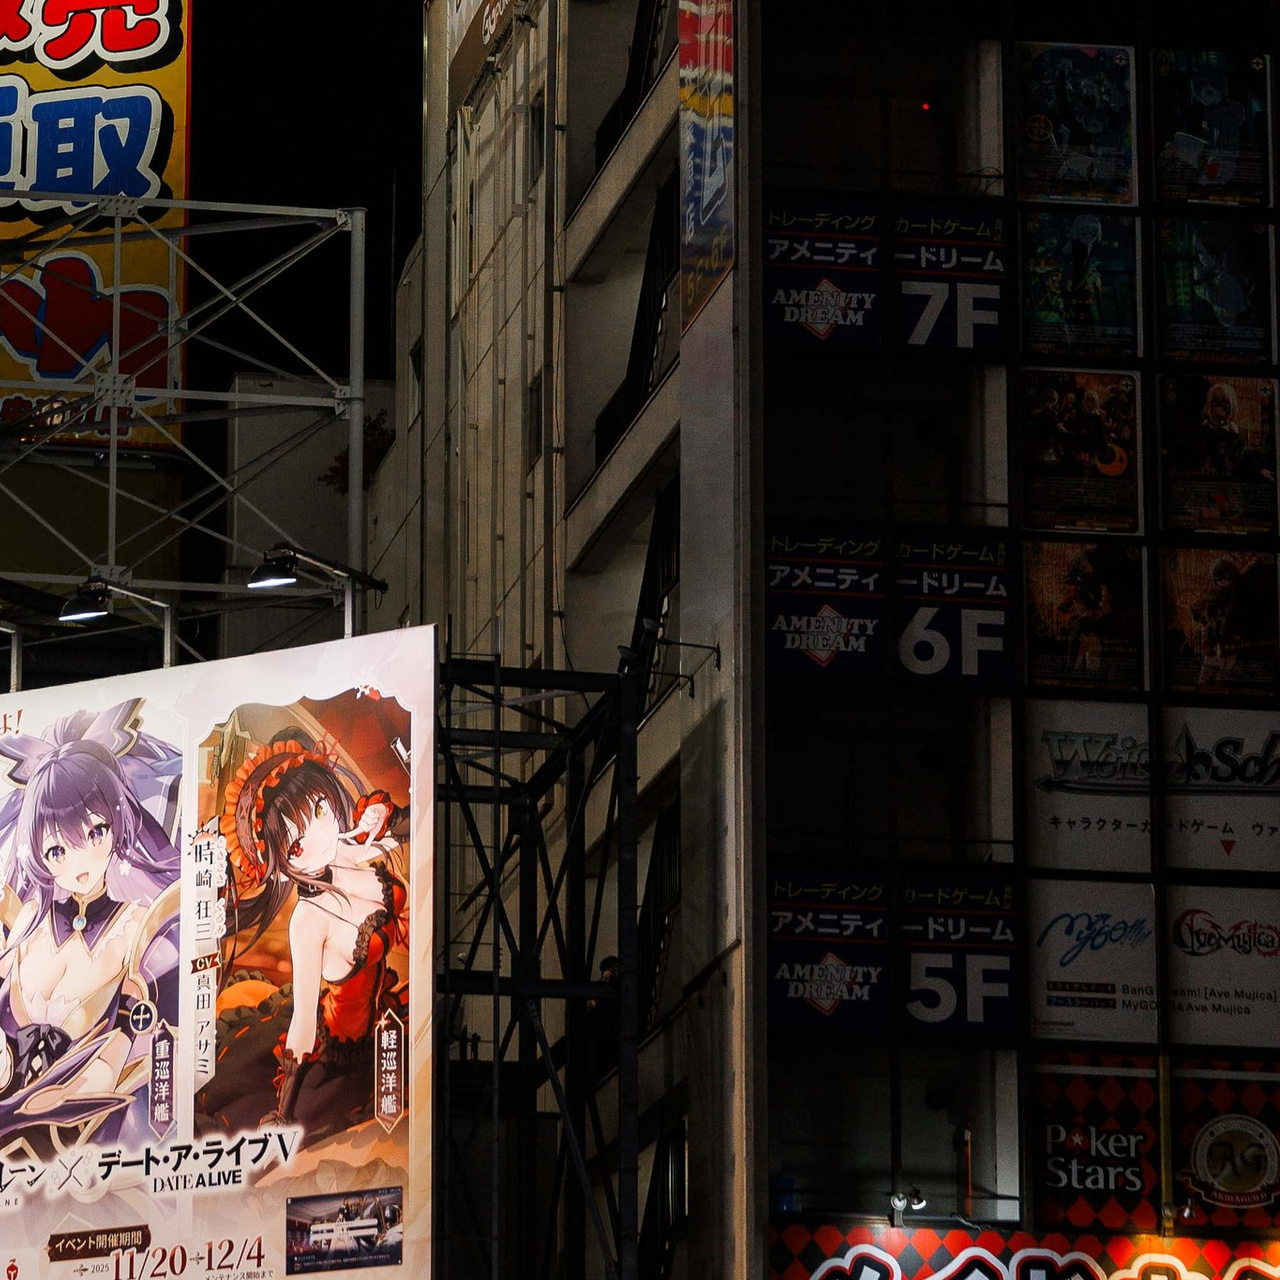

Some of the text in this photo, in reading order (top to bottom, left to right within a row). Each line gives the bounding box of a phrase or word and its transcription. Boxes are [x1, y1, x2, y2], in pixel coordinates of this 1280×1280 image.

[770, 288, 877, 310] AMENITY
[783, 306, 865, 326] DREAM
[901, 280, 1001, 349] 7F
[770, 614, 880, 635] AMENITY
[783, 631, 868, 653] DREAM
[898, 606, 1006, 677] 6F
[195, 957, 213, 970] CV
[774, 962, 884, 984] AMENITY
[787, 980, 871, 1002] DREAM
[905, 952, 1012, 1023] 5F
[154, 1040, 171, 1123] 重巡洋艦
[380, 1029, 398, 1115] 軽巡洋艦
[152, 1173, 194, 1194] DATE
[1046, 1157, 1143, 1192] Stars
[54, 1230, 143, 1253] イベント開催期間
[91, 1263, 110, 1274] 2025
[204, 1235, 266, 1272] 12/4
